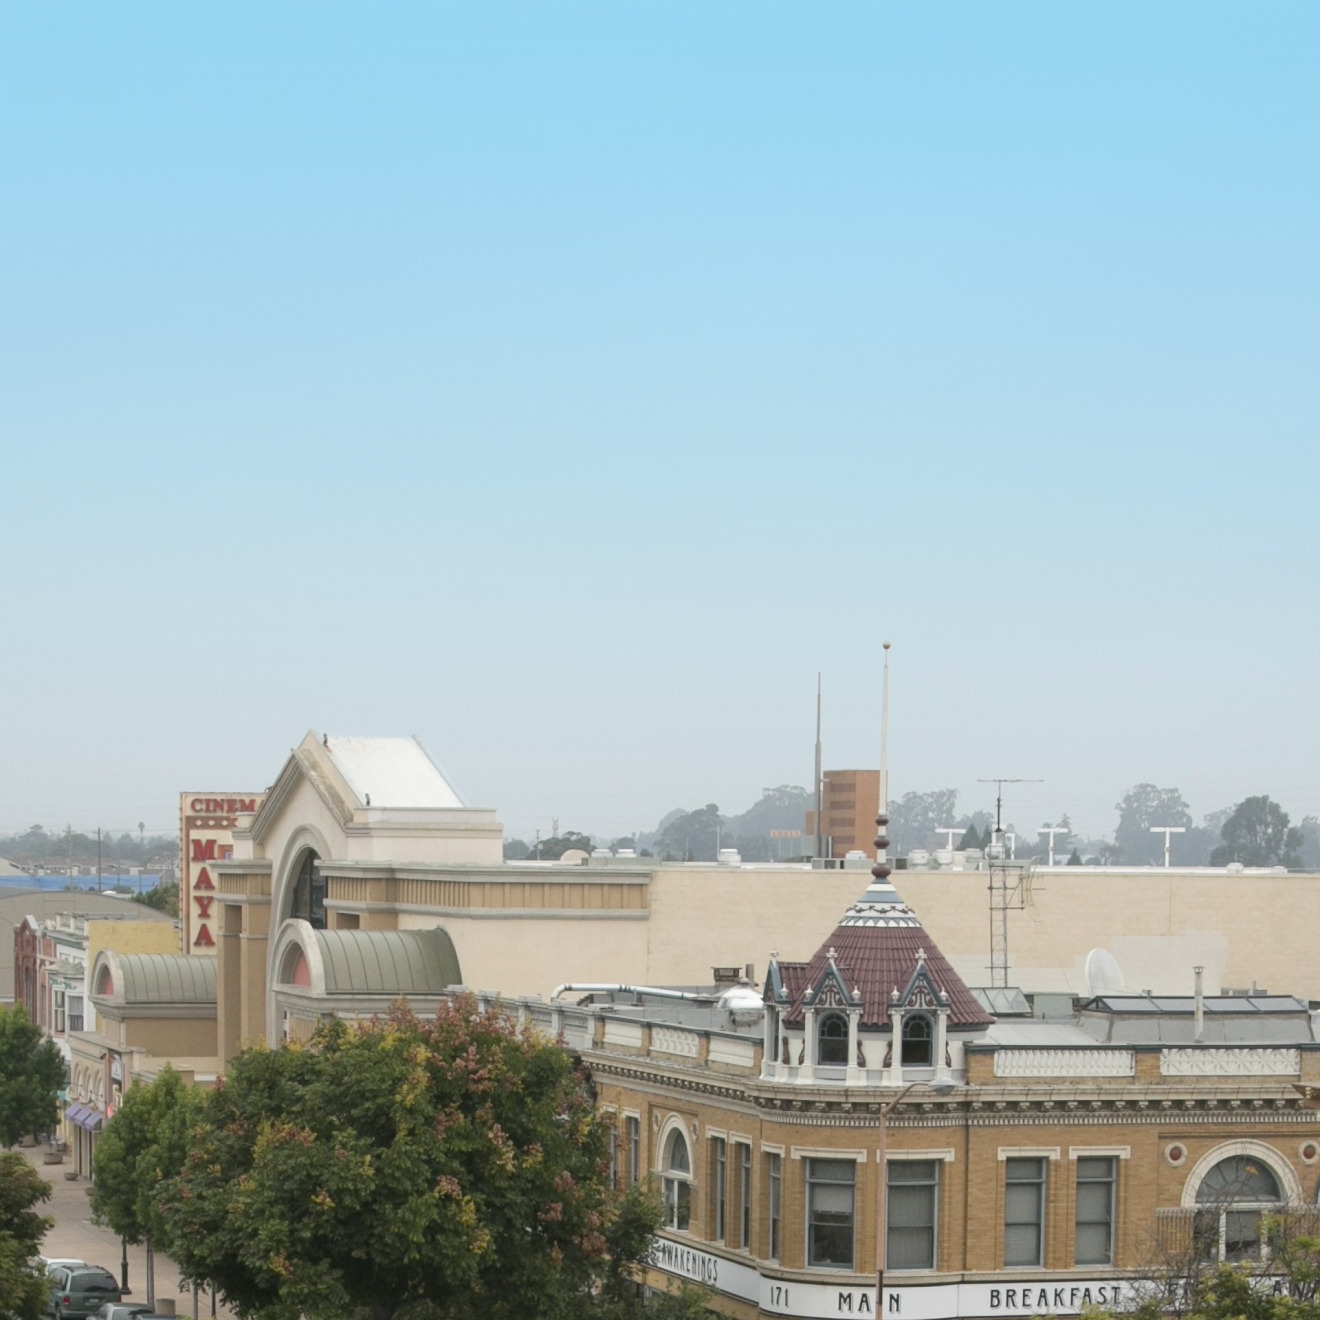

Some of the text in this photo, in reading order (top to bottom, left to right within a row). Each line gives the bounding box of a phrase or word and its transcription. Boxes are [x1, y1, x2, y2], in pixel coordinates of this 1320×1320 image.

[191, 798, 265, 813] CINEM
[191, 839, 216, 946] MAYA
[661, 1242, 718, 1282] AWAKENINGS
[770, 1286, 789, 1307] 171
[838, 1291, 902, 1314] MAN
[990, 1286, 1121, 1309] BREAKFAST
